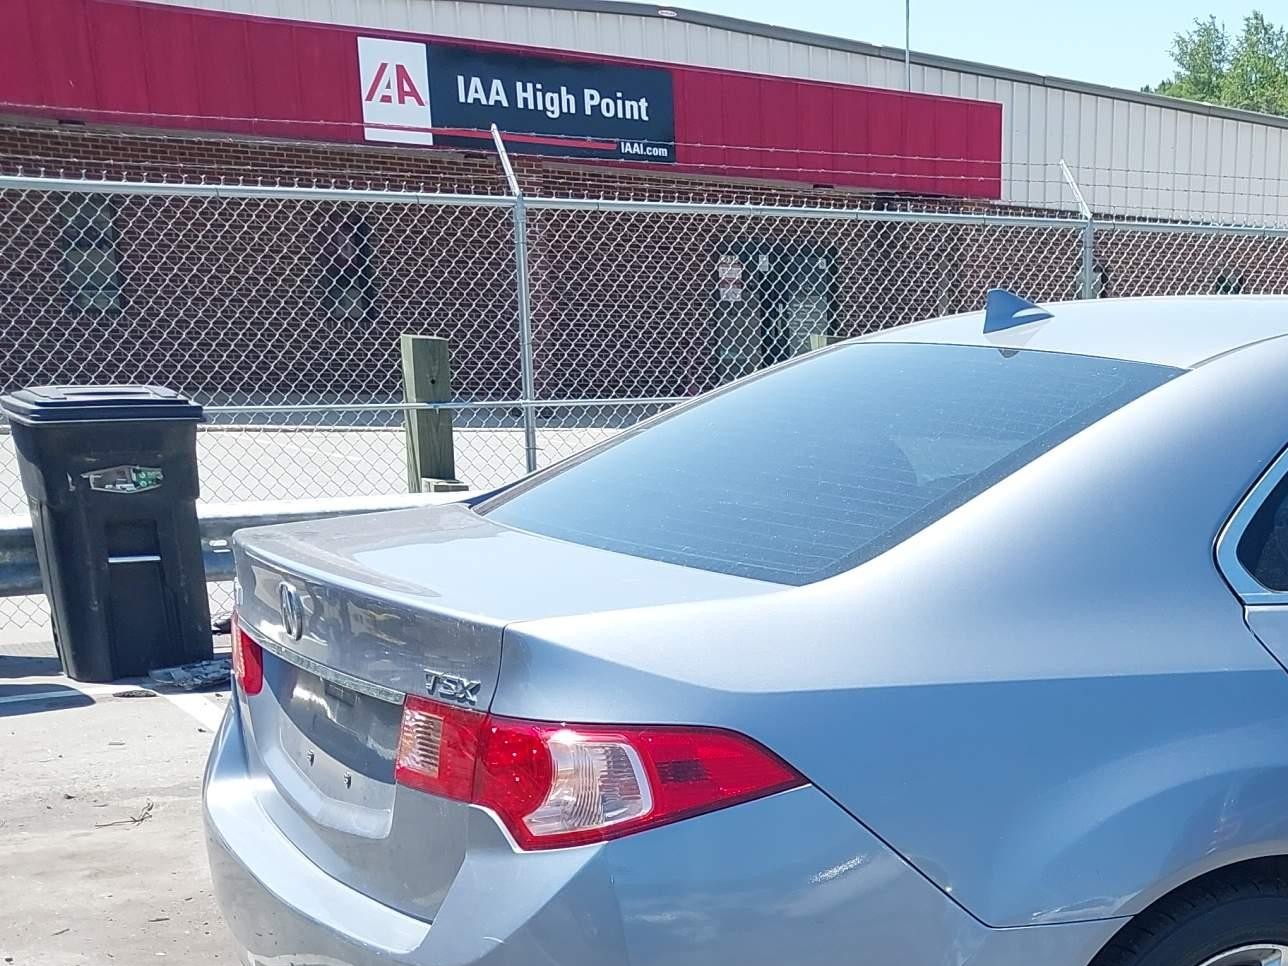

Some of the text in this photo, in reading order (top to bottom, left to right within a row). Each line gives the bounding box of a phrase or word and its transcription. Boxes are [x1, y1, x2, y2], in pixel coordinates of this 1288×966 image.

[457, 75, 649, 121] IAA High Point
[620, 141, 668, 157] IAAI.com
[424, 669, 481, 705] TSX
